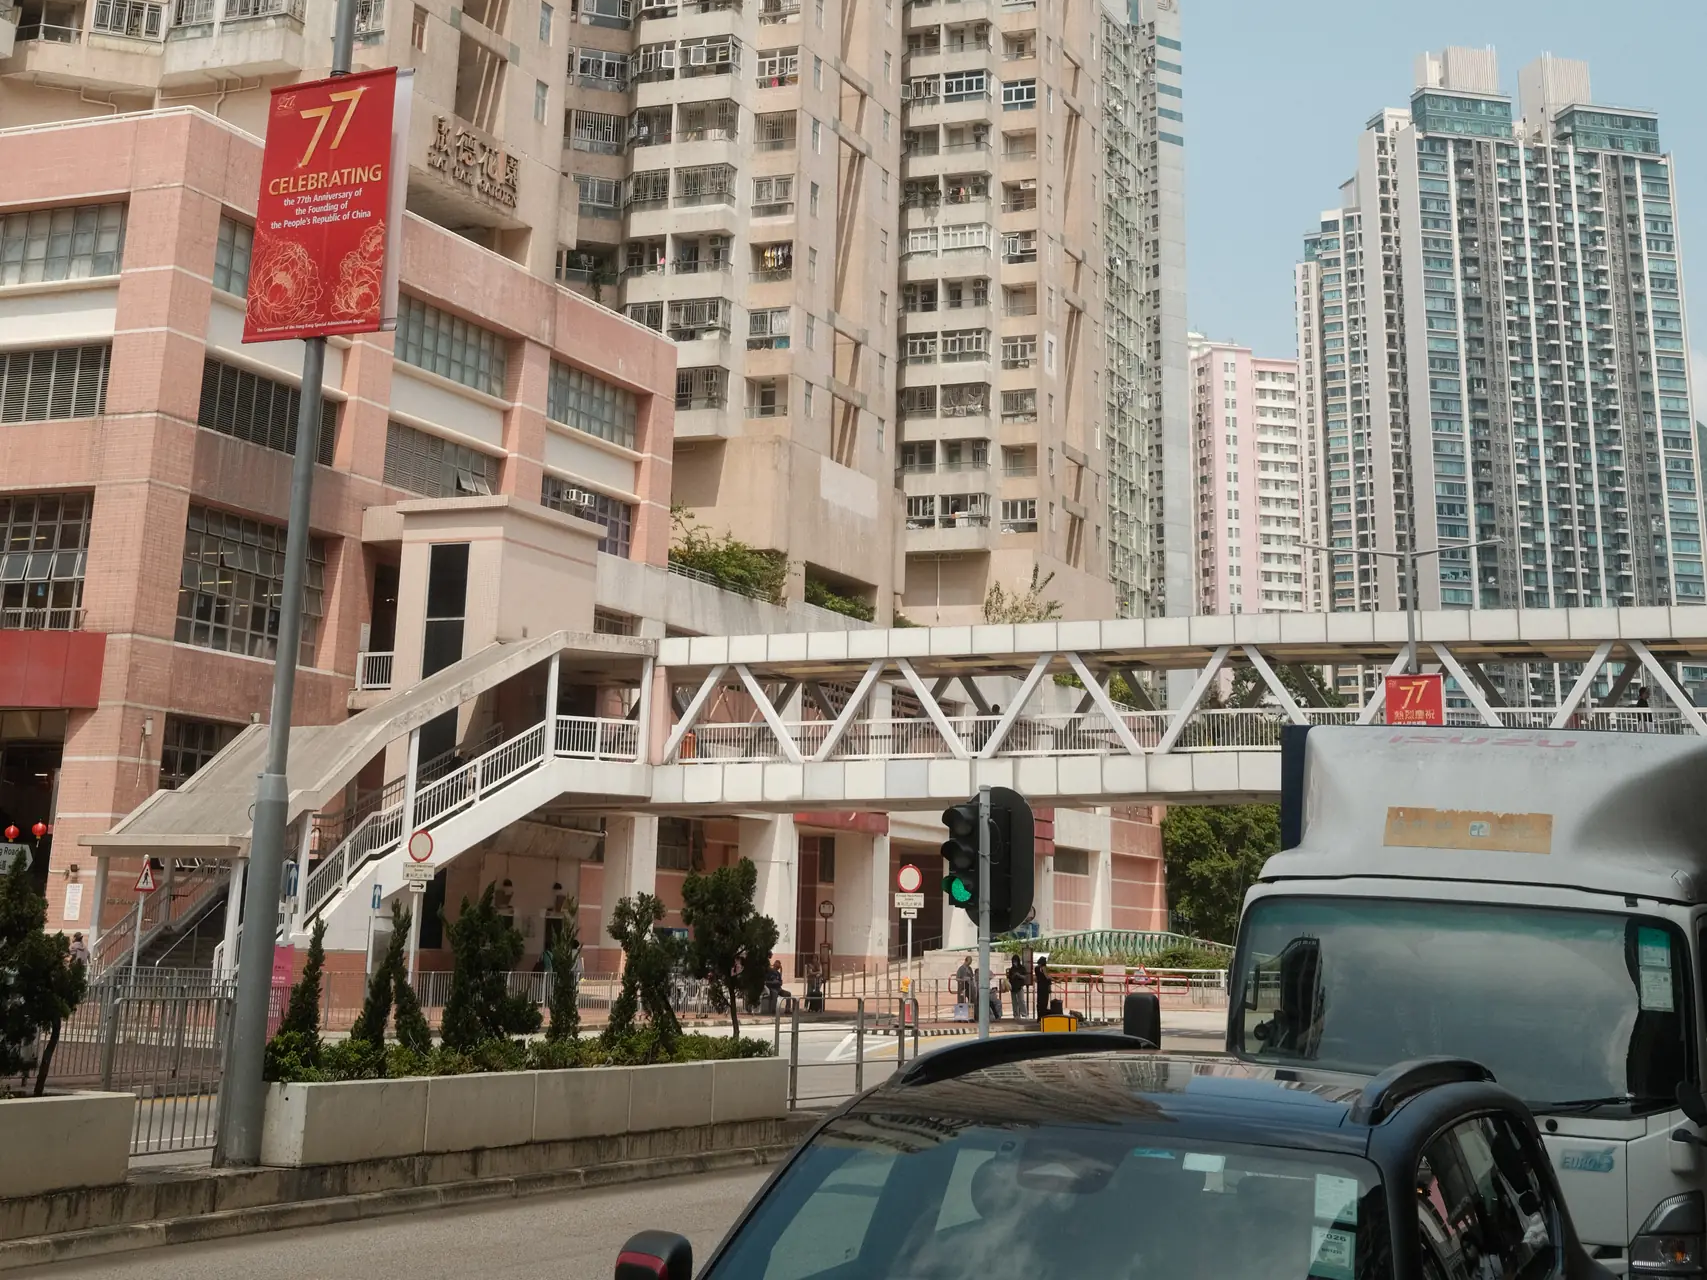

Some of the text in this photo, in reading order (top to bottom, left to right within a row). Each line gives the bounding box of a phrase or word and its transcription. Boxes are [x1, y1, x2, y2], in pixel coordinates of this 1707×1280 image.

[300, 88, 364, 166] 77
[268, 164, 382, 196] CELEBRATING
[283, 188, 363, 206] the 77th Anniversary of
[295, 201, 349, 215] the Founding of
[270, 209, 371, 229] the People's Republic of China
[1400, 680, 1430, 709] 77
[1388, 735, 1578, 748] ISUZU
